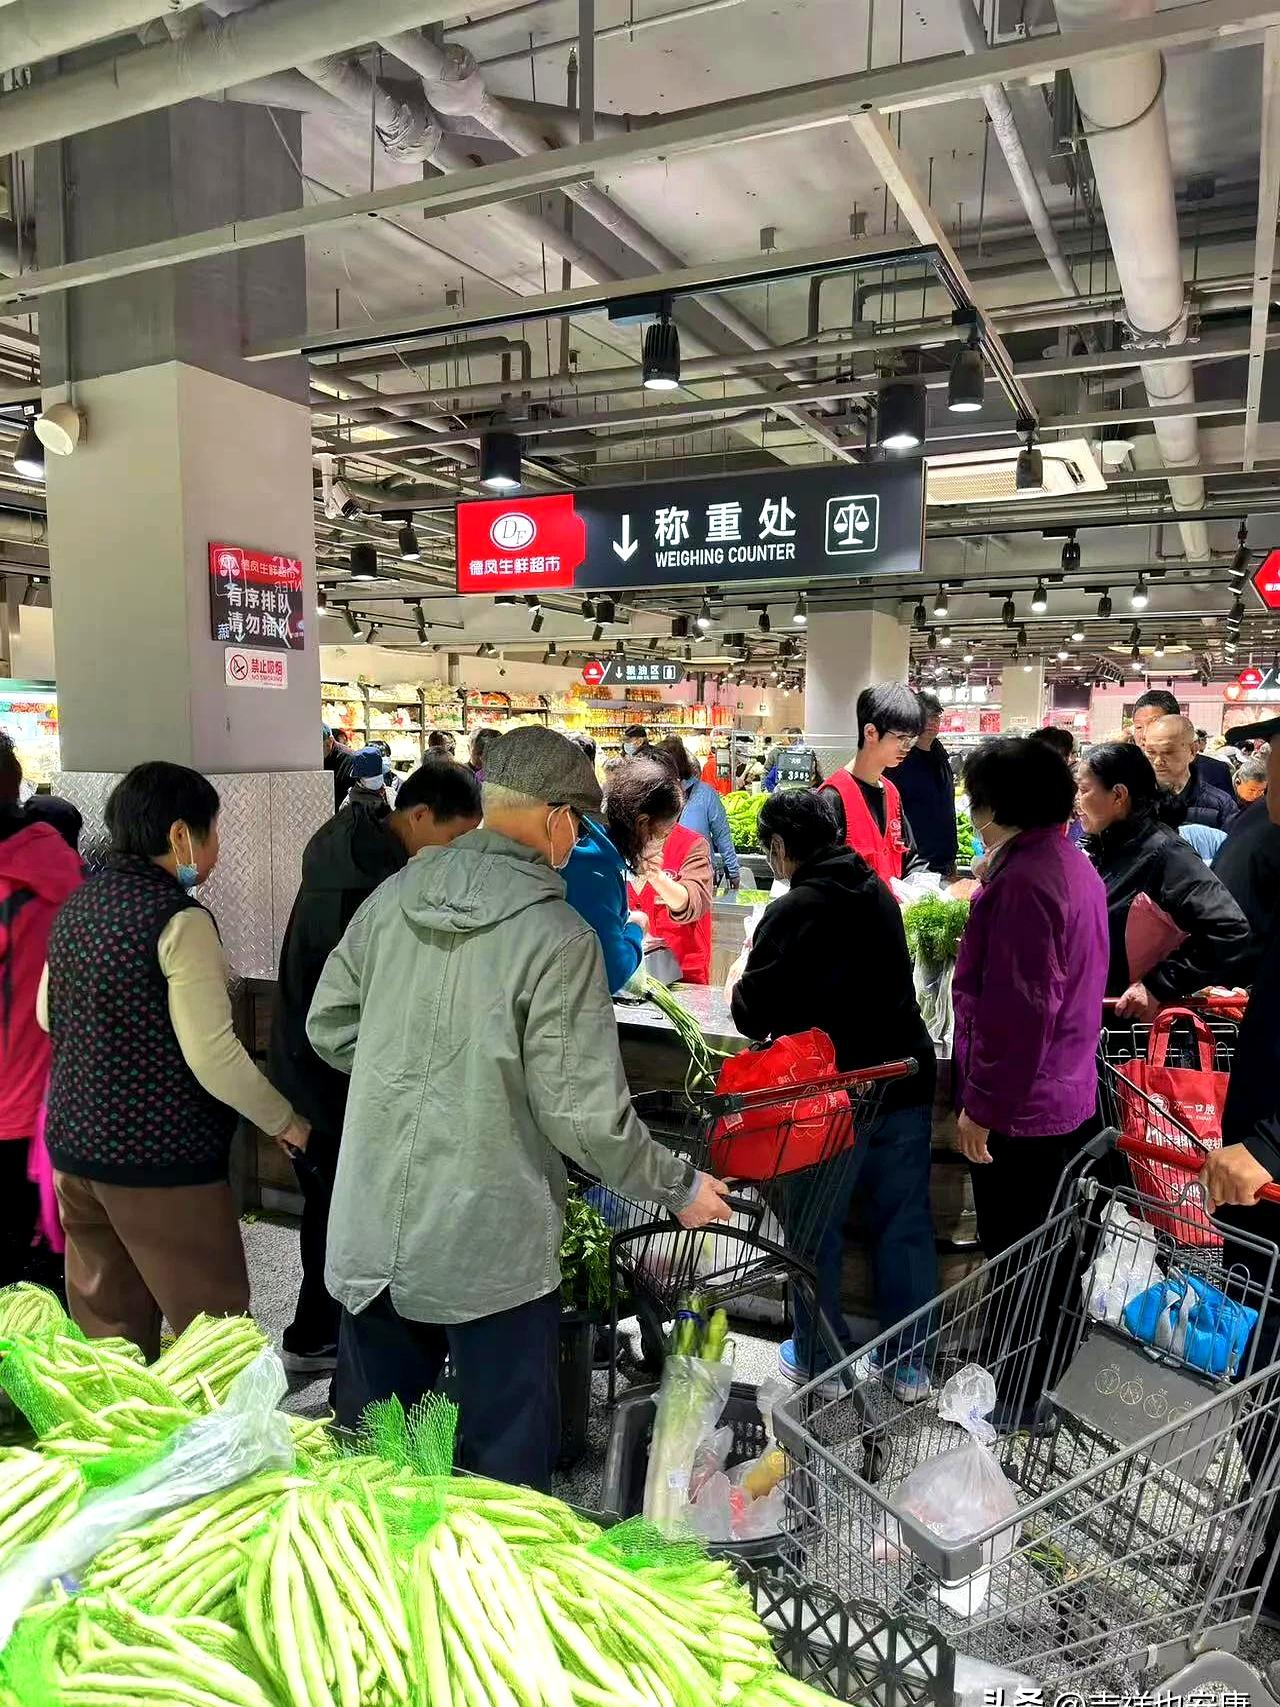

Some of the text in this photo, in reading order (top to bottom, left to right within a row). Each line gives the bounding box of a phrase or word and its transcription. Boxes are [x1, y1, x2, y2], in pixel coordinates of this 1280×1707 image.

[655, 497, 797, 548] 称重处
[469, 555, 560, 576] 德凤生鲜超市
[655, 542, 796, 568] WEIGHING COUNTER
[228, 587, 292, 615] 有序排队
[228, 611, 293, 639] 请勿插队
[251, 658, 282, 675] 禁止吸烟
